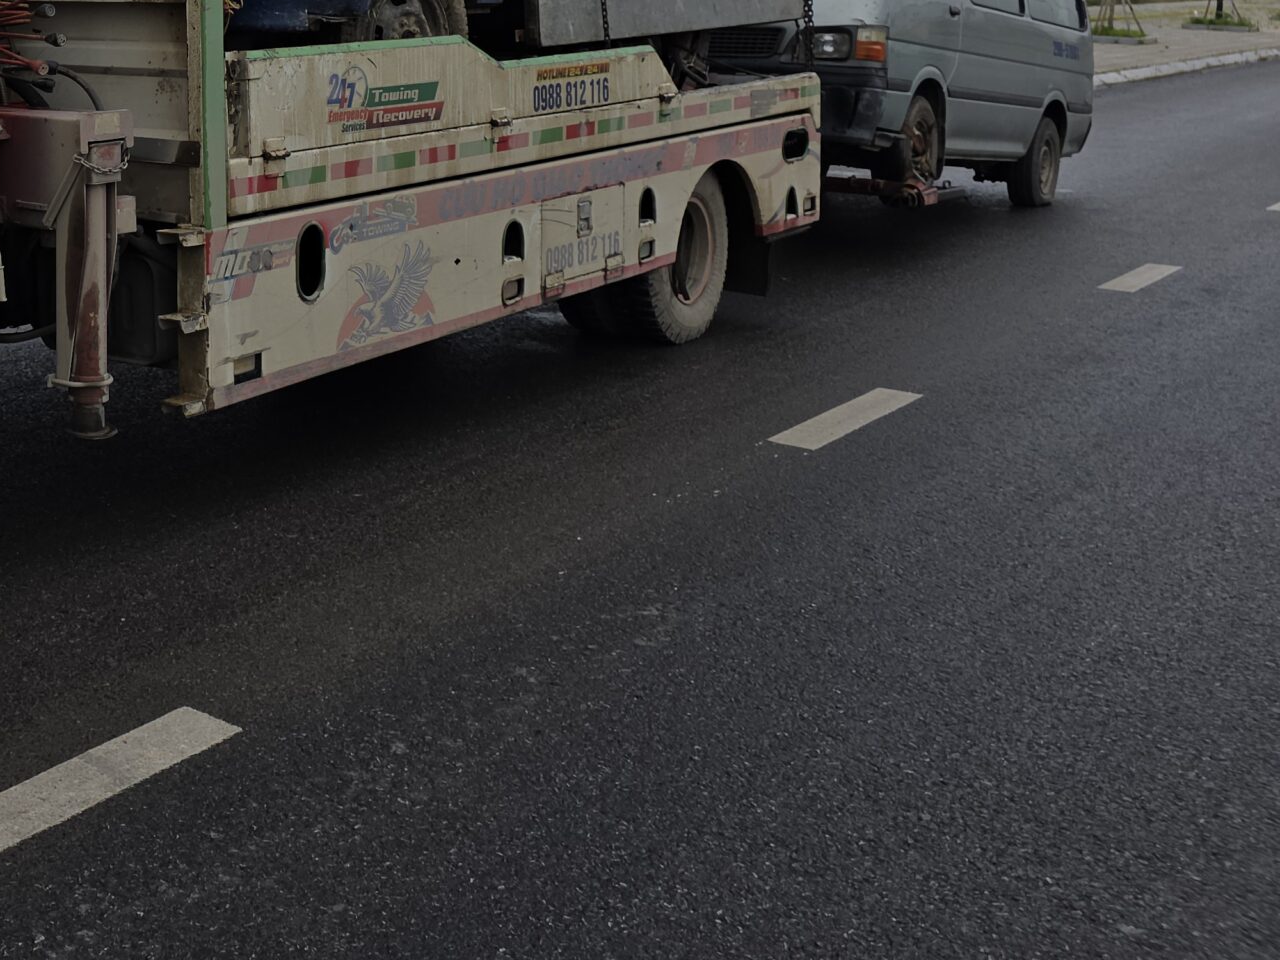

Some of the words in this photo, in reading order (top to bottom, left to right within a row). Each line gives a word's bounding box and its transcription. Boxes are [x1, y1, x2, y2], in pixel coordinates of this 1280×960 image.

[372, 87, 419, 102] Towing
[533, 84, 562, 112] 0988
[565, 79, 587, 107] 812
[589, 76, 610, 104] 116
[372, 107, 436, 124] Recovery
[341, 121, 366, 133] Services
[546, 242, 574, 273] 0988
[577, 236, 598, 265] 812
[601, 230, 620, 258] 116
